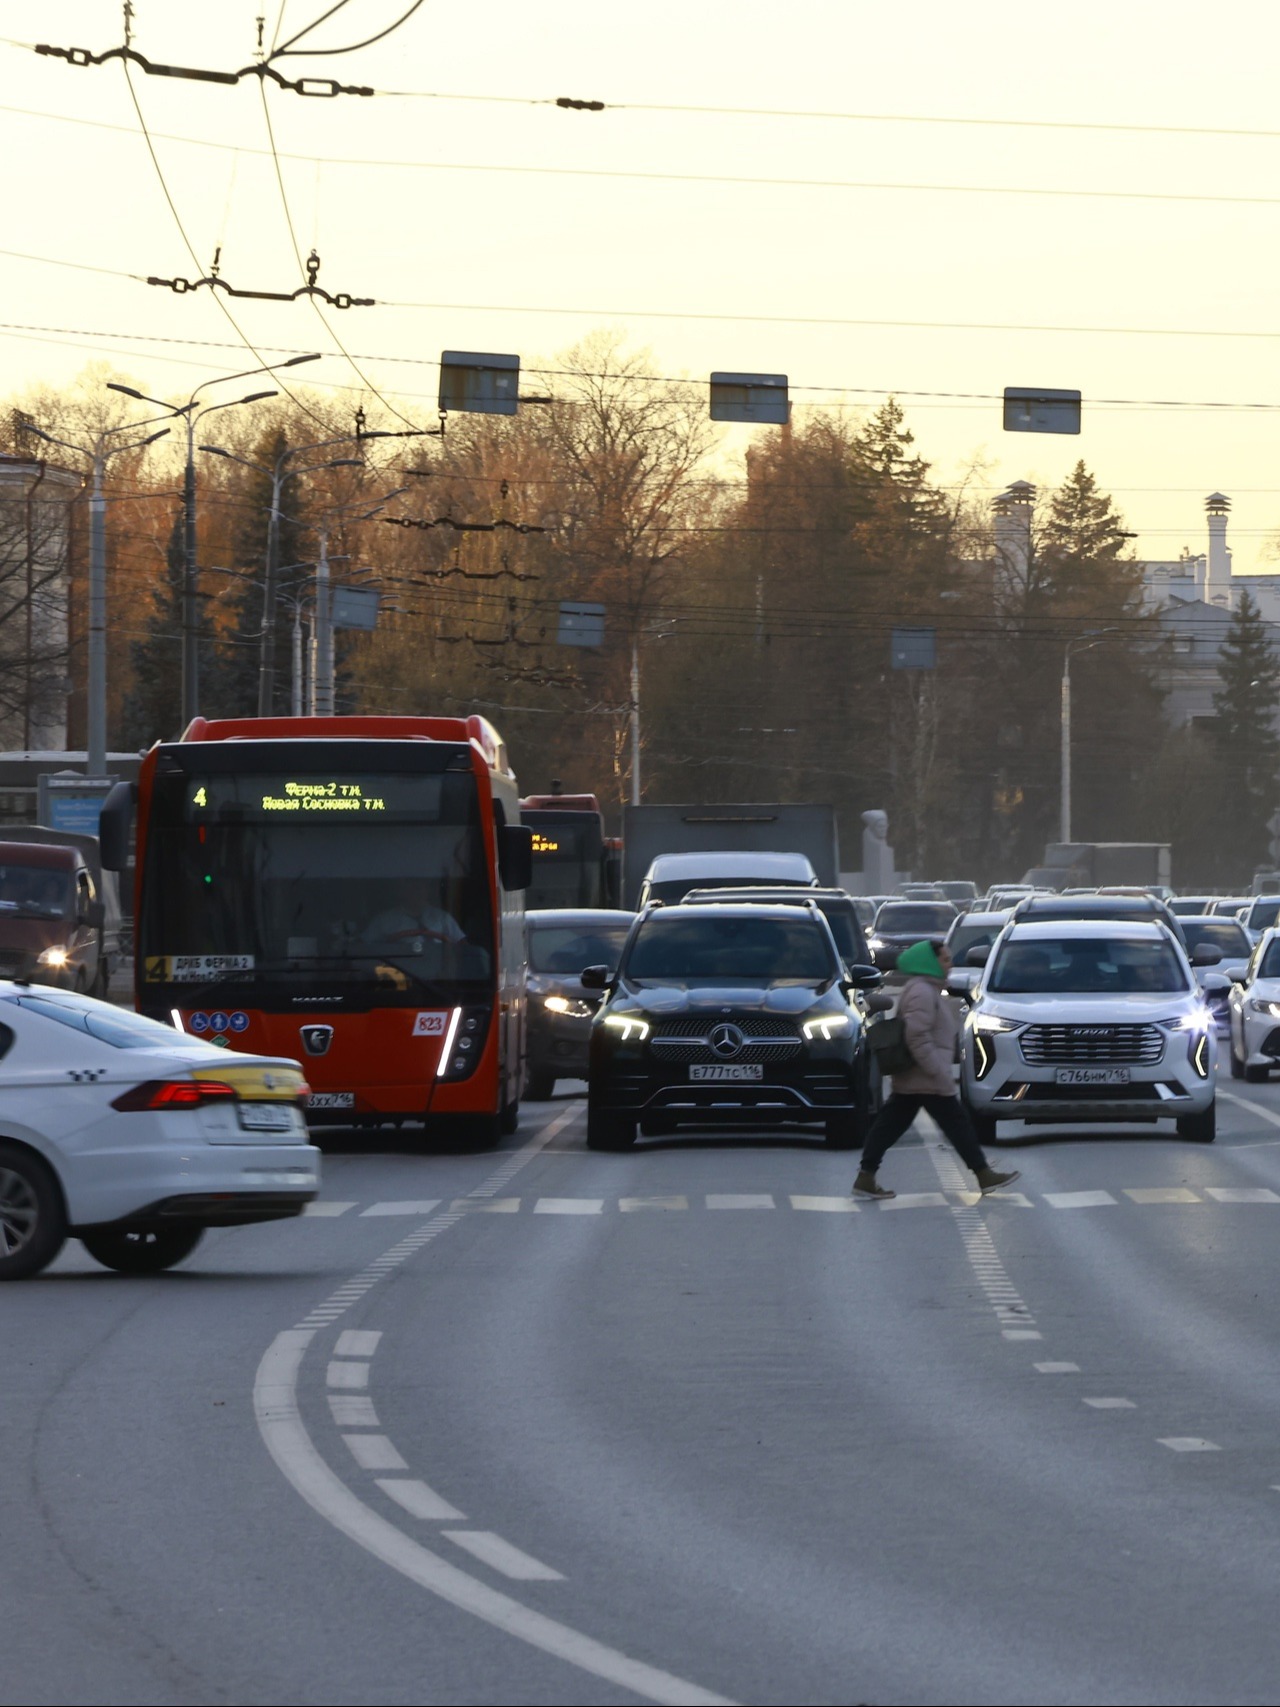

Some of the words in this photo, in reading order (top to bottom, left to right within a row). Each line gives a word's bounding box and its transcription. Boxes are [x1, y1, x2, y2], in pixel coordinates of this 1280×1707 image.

[193, 787, 207, 807] 4
[149, 958, 168, 979] 4
[419, 1016, 442, 1031] 823
